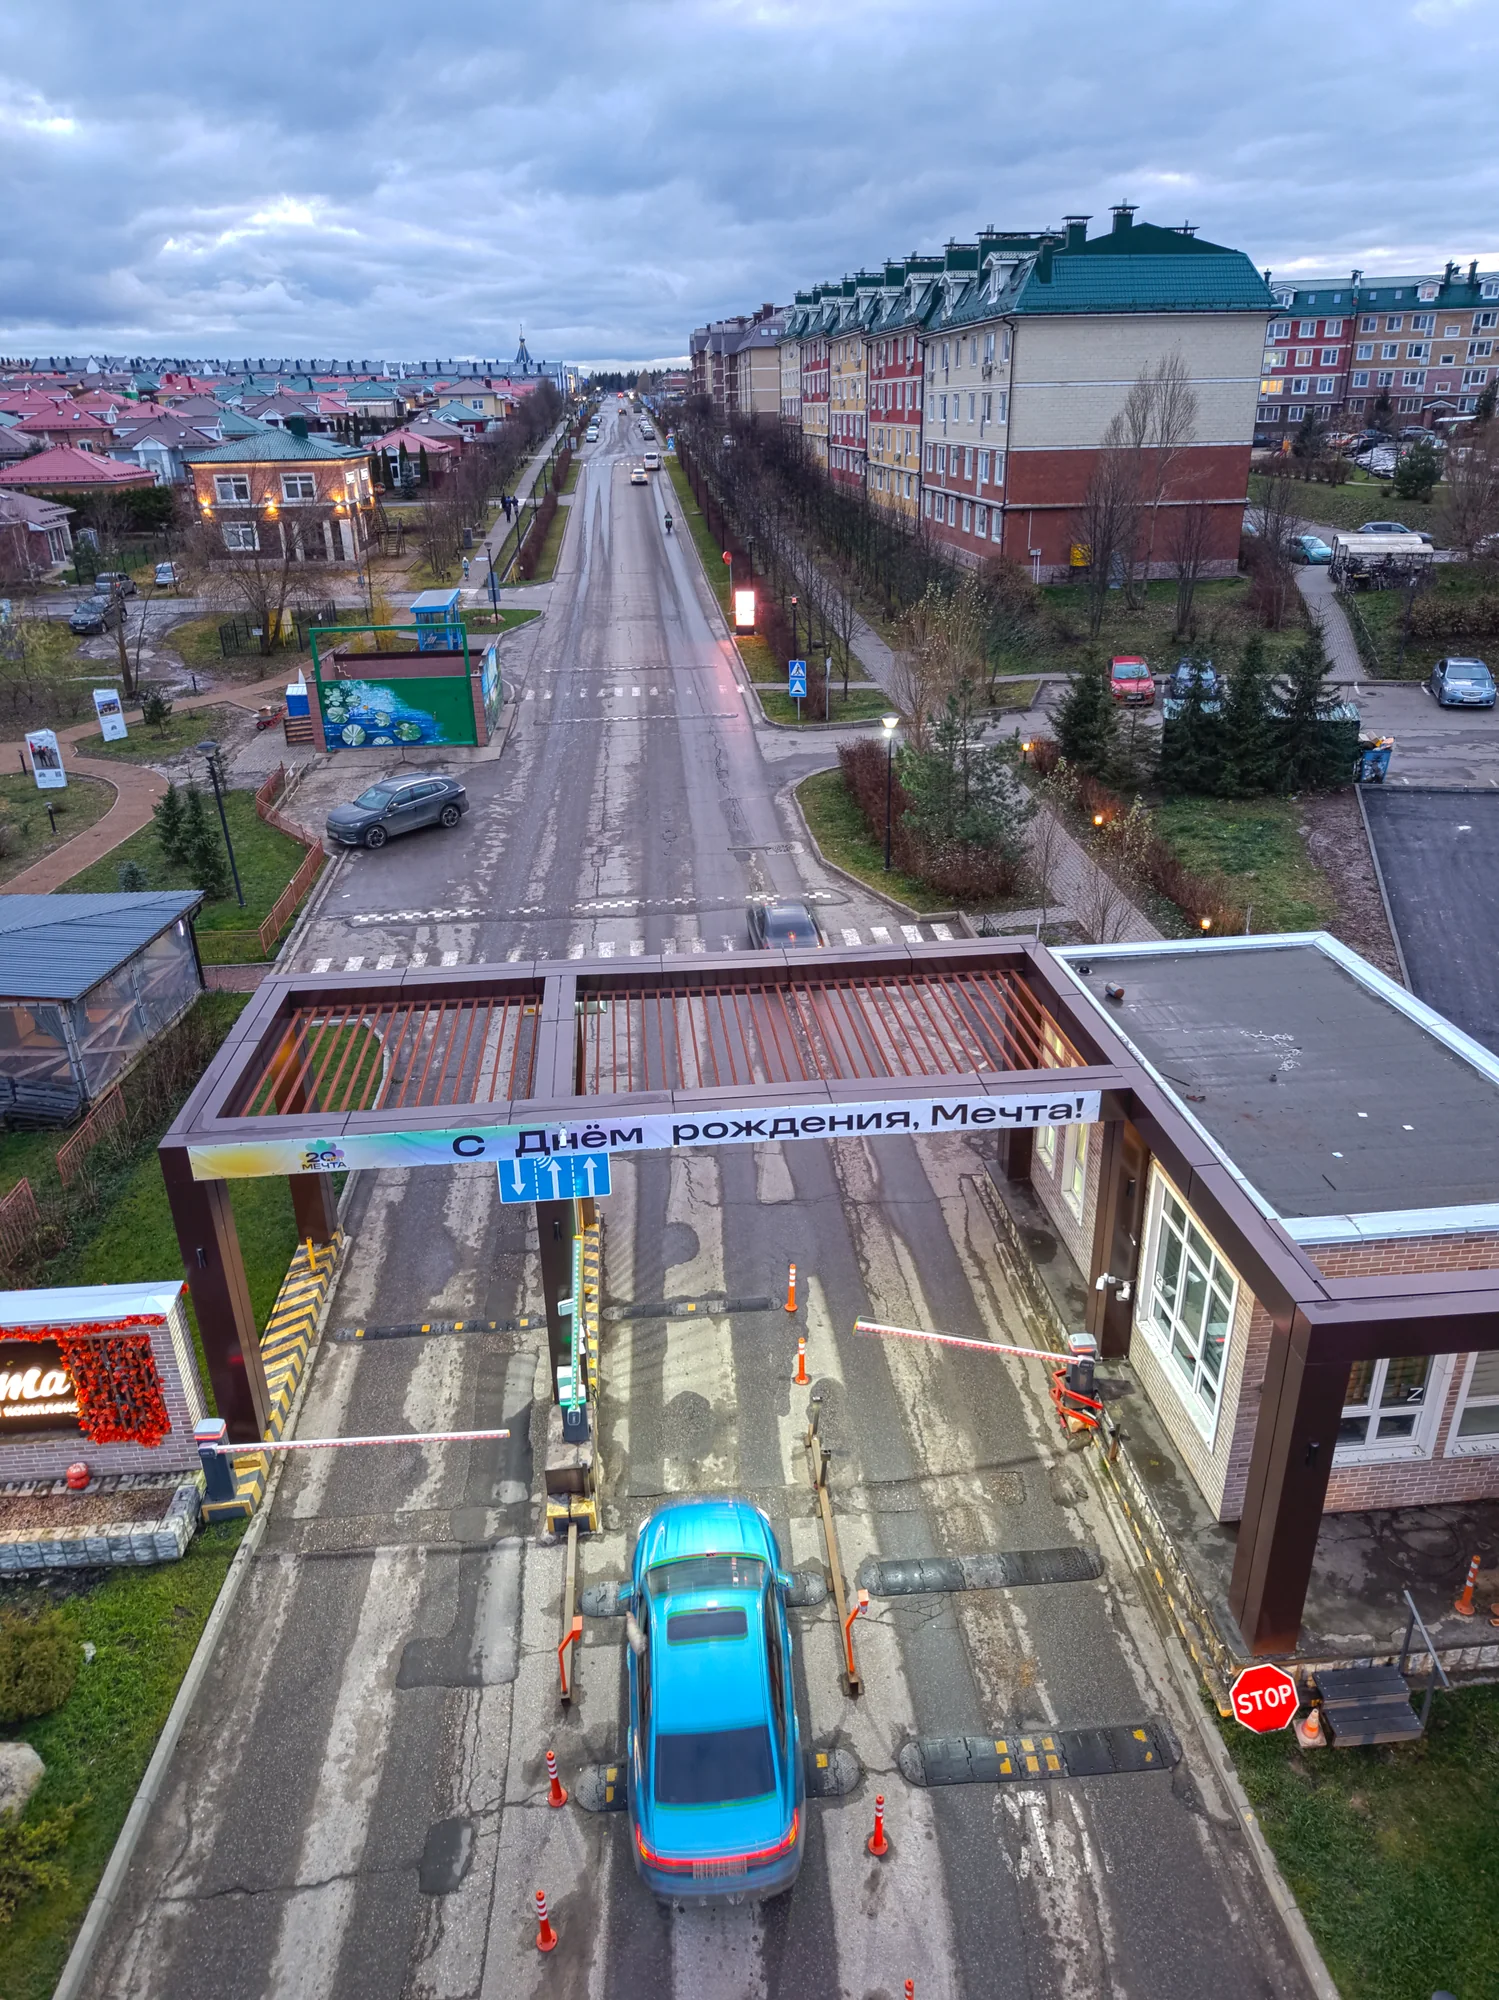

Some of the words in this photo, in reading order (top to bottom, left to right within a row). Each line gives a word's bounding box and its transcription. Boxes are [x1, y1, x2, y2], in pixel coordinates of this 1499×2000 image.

[515, 1124, 643, 1158] Днём
[672, 1111, 919, 1146] рождения,
[931, 1098, 1085, 1126] Мечта!
[305, 1151, 336, 1162] 20
[302, 1162, 346, 1170] МЕЧТА
[1406, 1387, 1424, 1402] Z
[1237, 1684, 1292, 1715] STOP
